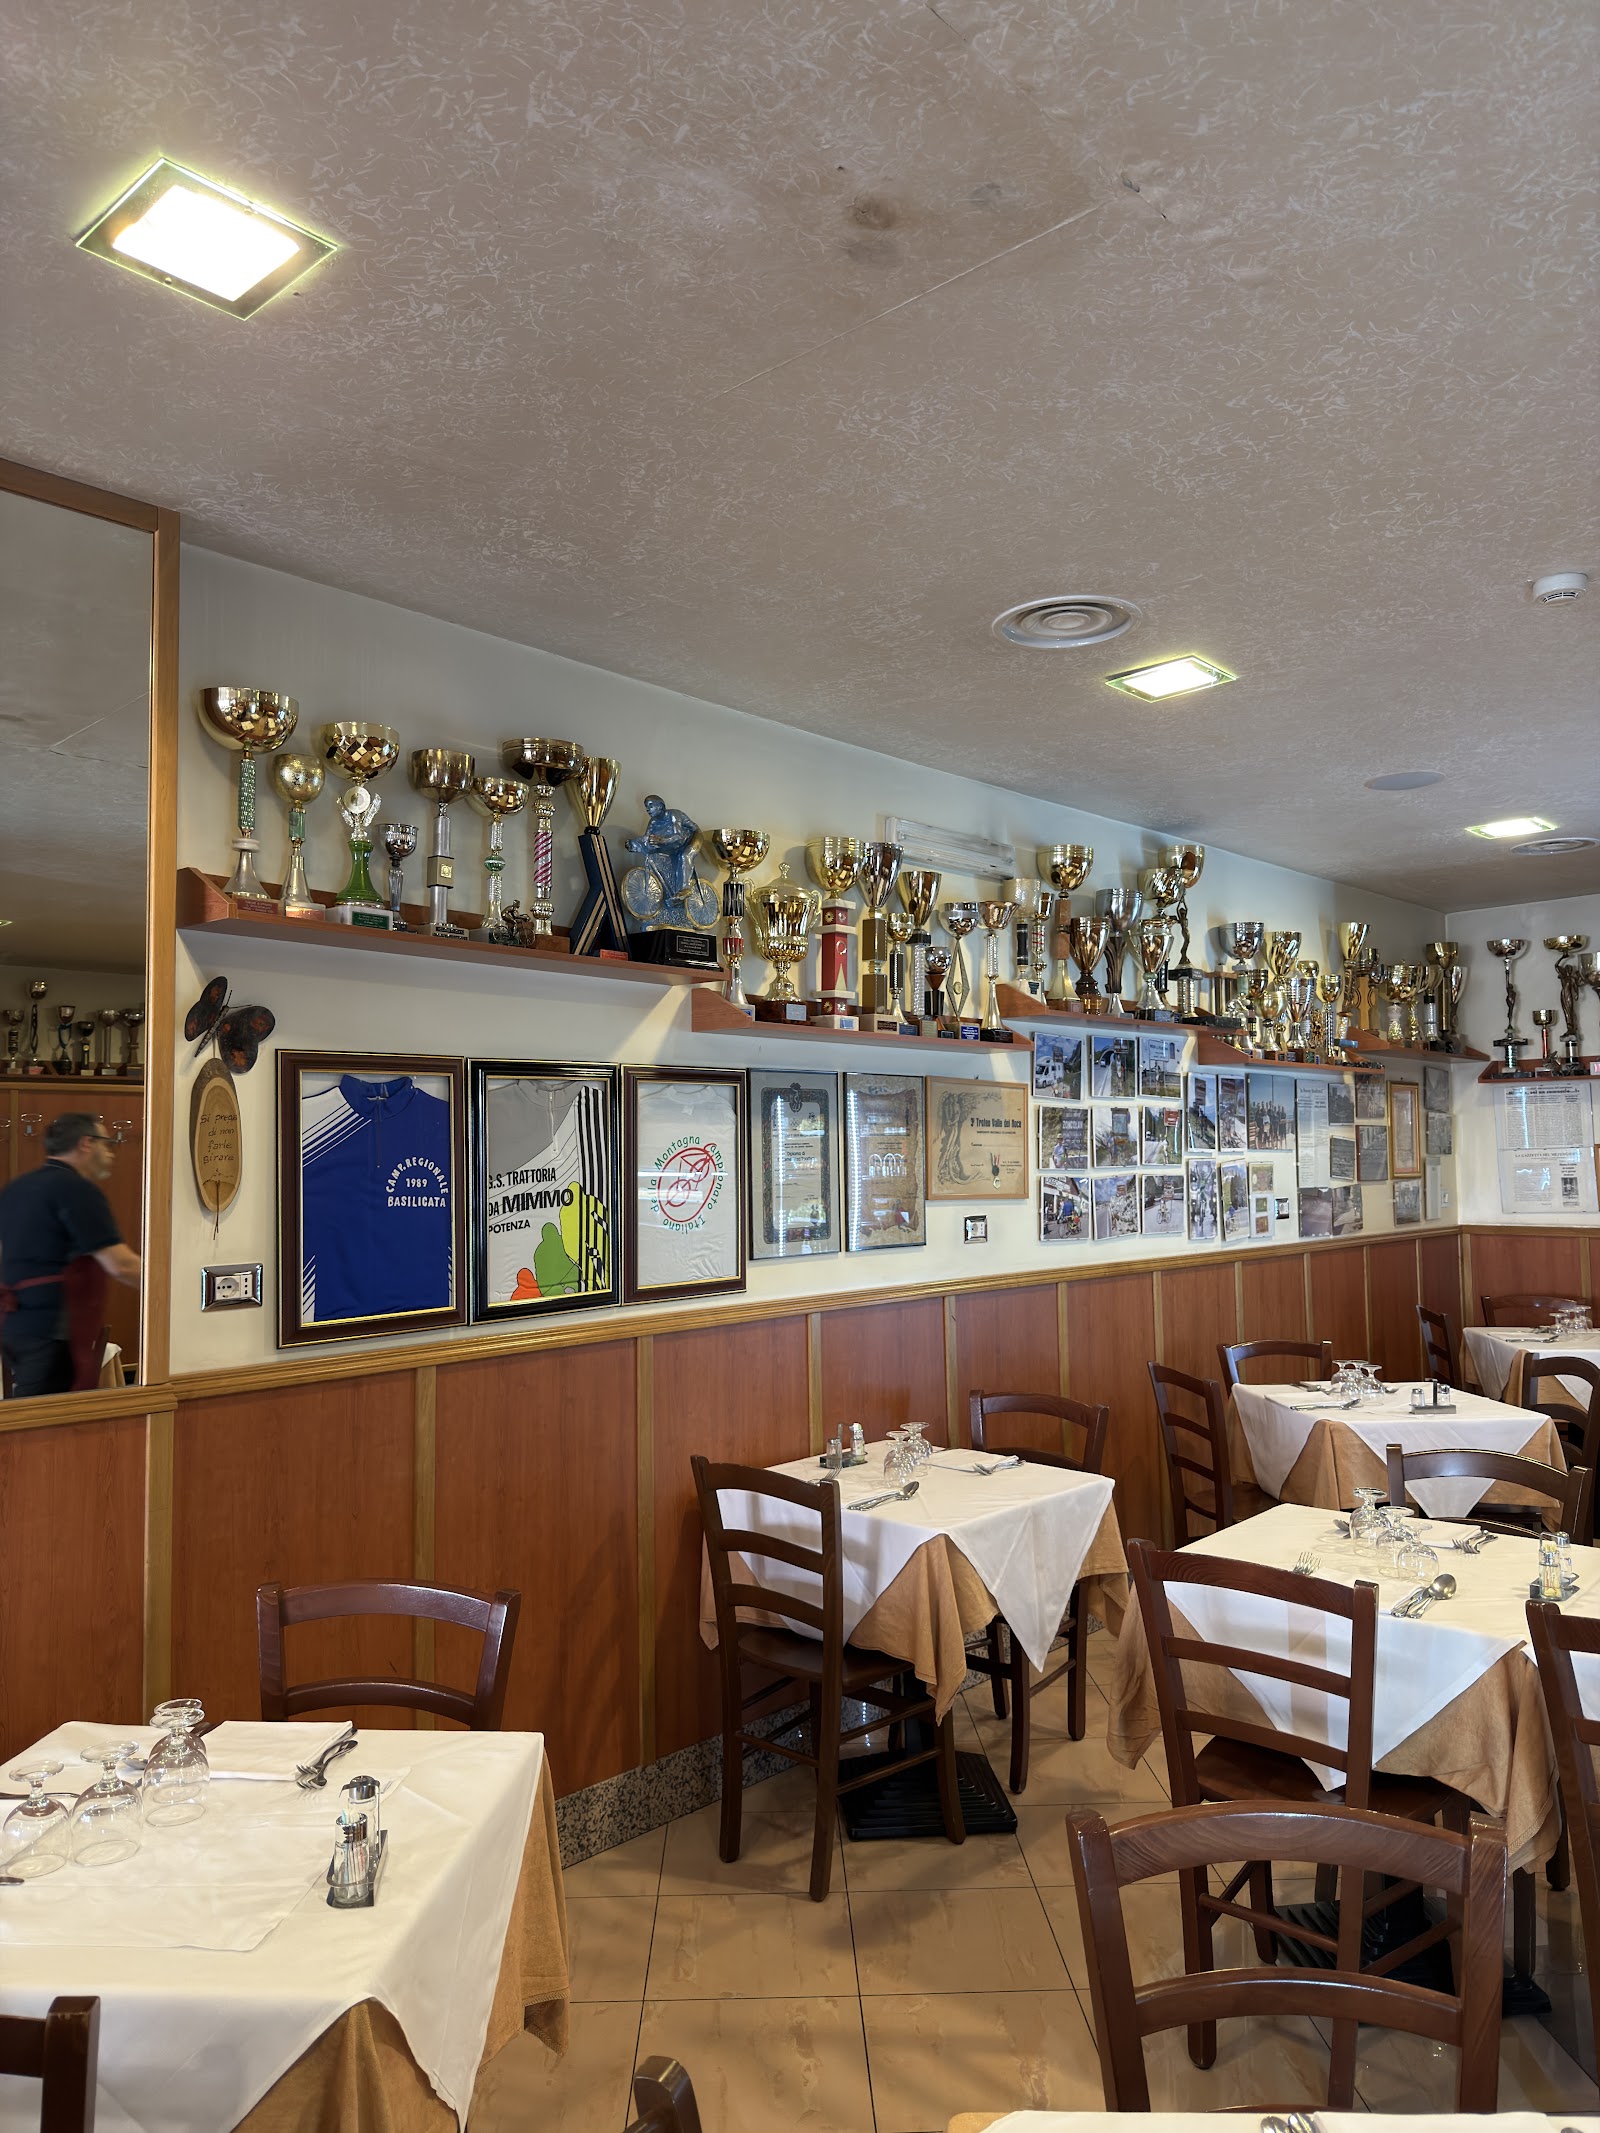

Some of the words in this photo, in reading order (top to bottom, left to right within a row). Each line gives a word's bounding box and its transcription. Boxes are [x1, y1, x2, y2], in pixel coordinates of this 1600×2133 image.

[200, 1114, 210, 1124] Si
[215, 1114, 237, 1124] prega
[208, 1127, 217, 1136] di
[208, 1140, 232, 1152] farle
[654, 1136, 700, 1170] Montagna
[406, 1178, 427, 1187] 1989
[506, 1168, 556, 1186] TRATTORIA
[387, 1196, 446, 1207] BASILICATA
[502, 1189, 574, 1214] MIMMO
[489, 1219, 530, 1234] POTENZA
[663, 1214, 706, 1234] Italiano
